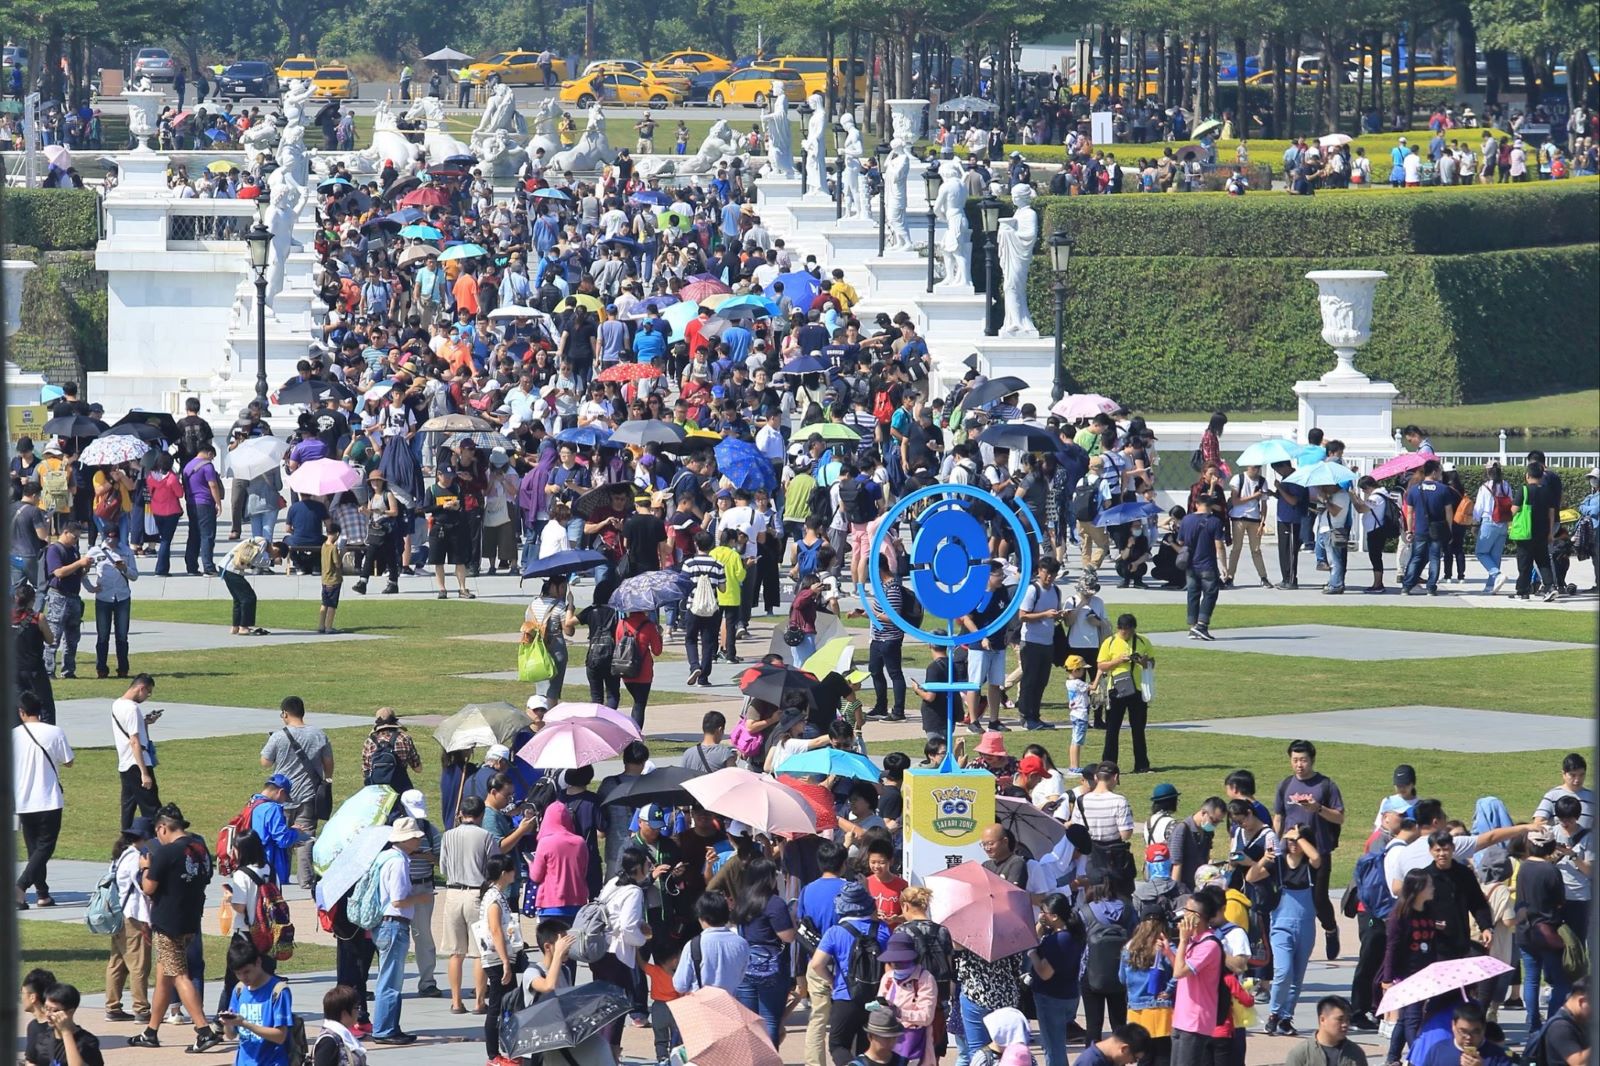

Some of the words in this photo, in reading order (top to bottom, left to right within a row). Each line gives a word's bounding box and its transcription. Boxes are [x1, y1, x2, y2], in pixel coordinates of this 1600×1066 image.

[830, 355, 841, 367] 11
[942, 801, 968, 814] GO
[936, 819, 957, 829] SAFARI
[959, 819, 974, 829] ZONE
